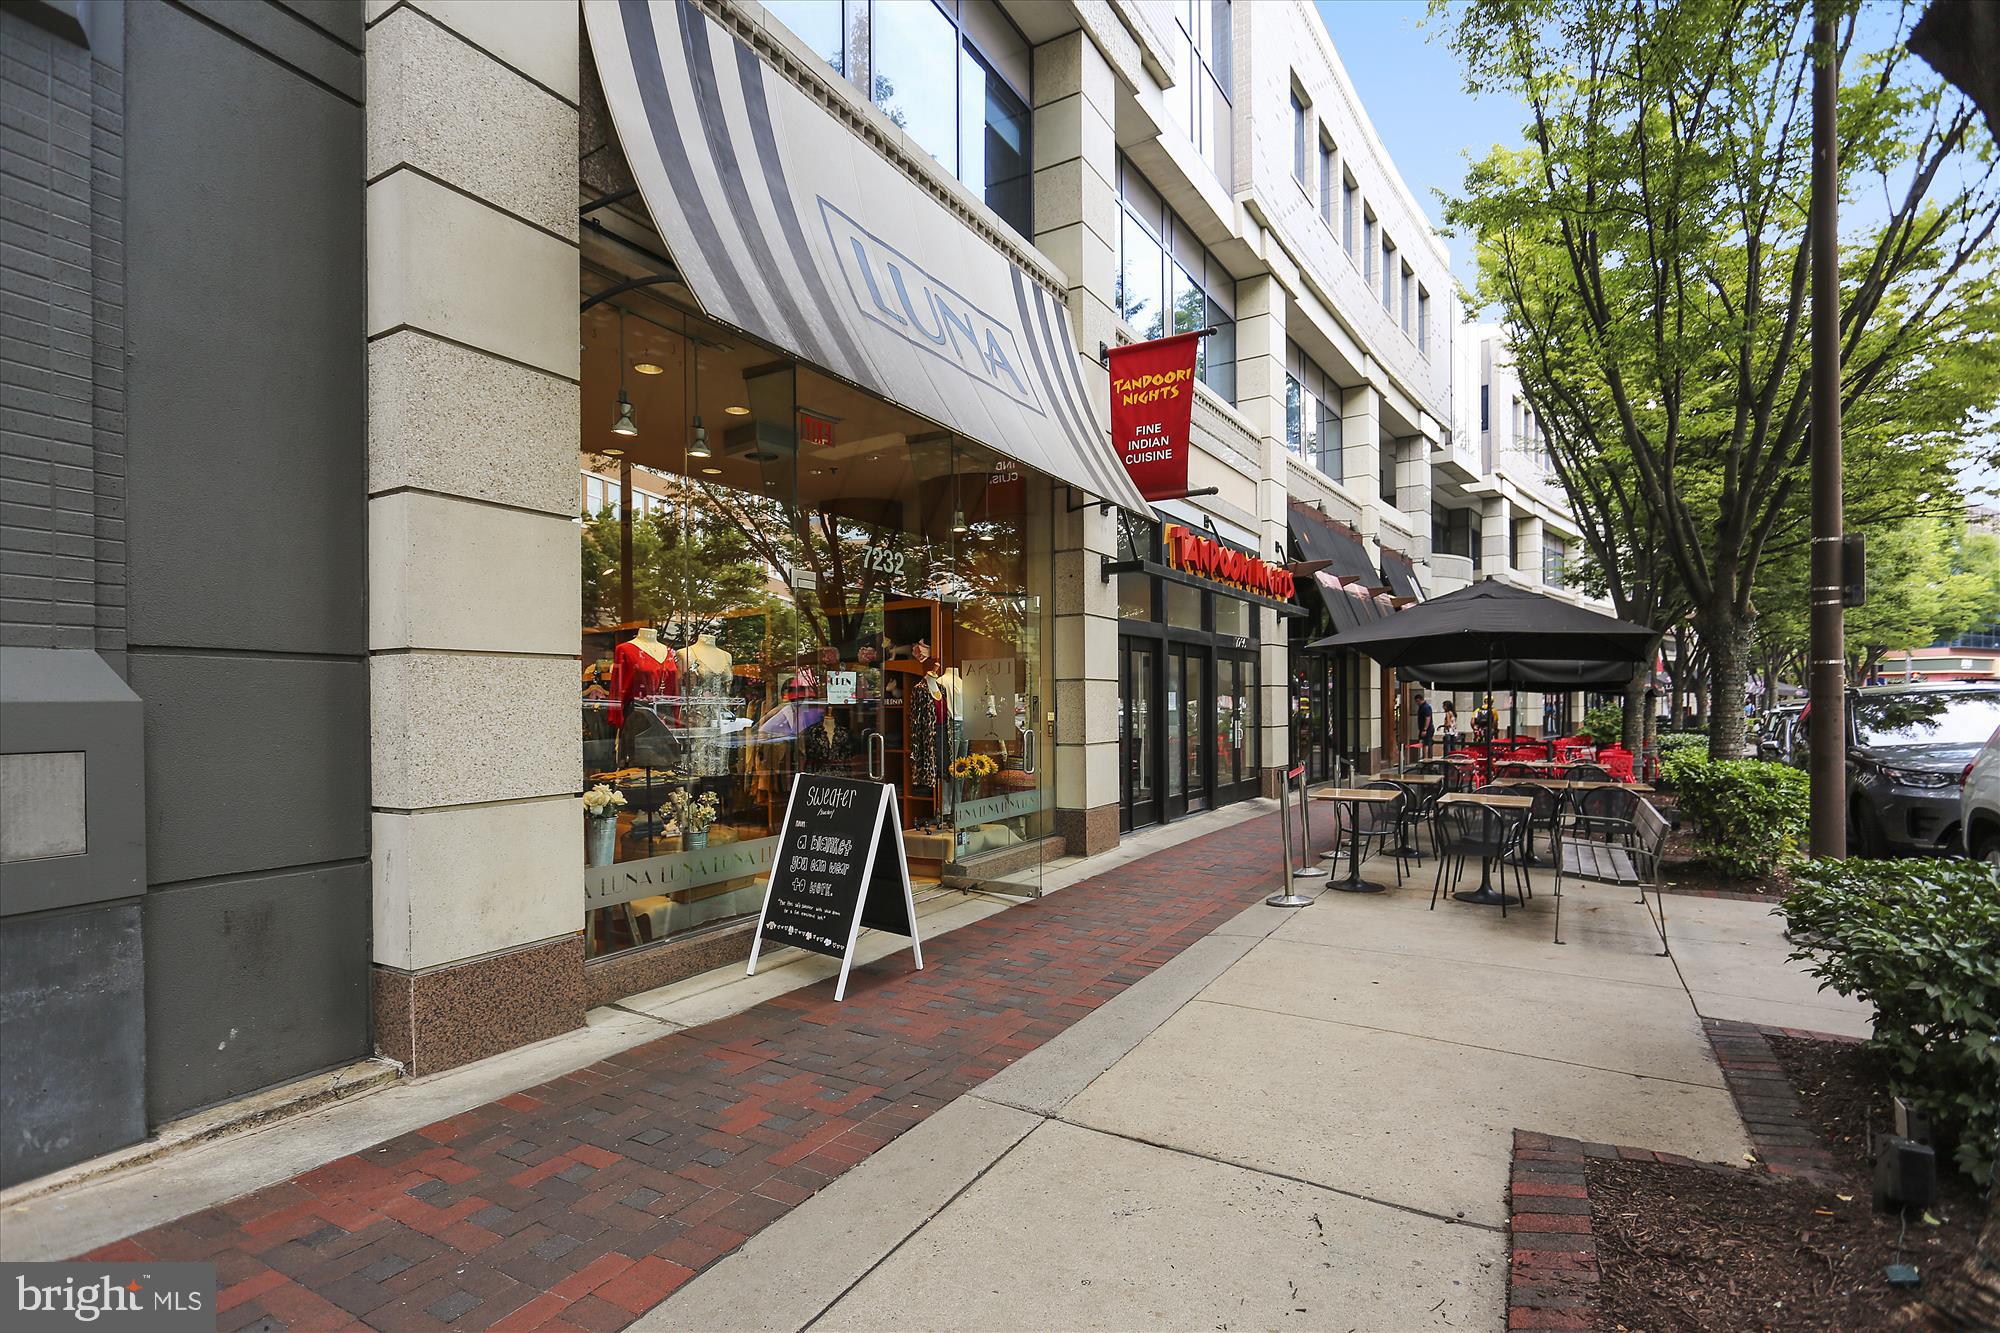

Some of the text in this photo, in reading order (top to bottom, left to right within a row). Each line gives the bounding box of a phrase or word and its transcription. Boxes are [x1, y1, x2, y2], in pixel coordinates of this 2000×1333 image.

[850, 236, 1028, 395] LUNA
[1113, 367, 1191, 394] TANDOORI
[1123, 384, 1180, 407] NIGHTS
[1136, 422, 1162, 436] FINE
[1128, 435, 1169, 451] INDIAN
[1125, 448, 1173, 465] CUISINE
[863, 545, 905, 576] 7232
[789, 855, 809, 872] you
[791, 877, 806, 893] to
